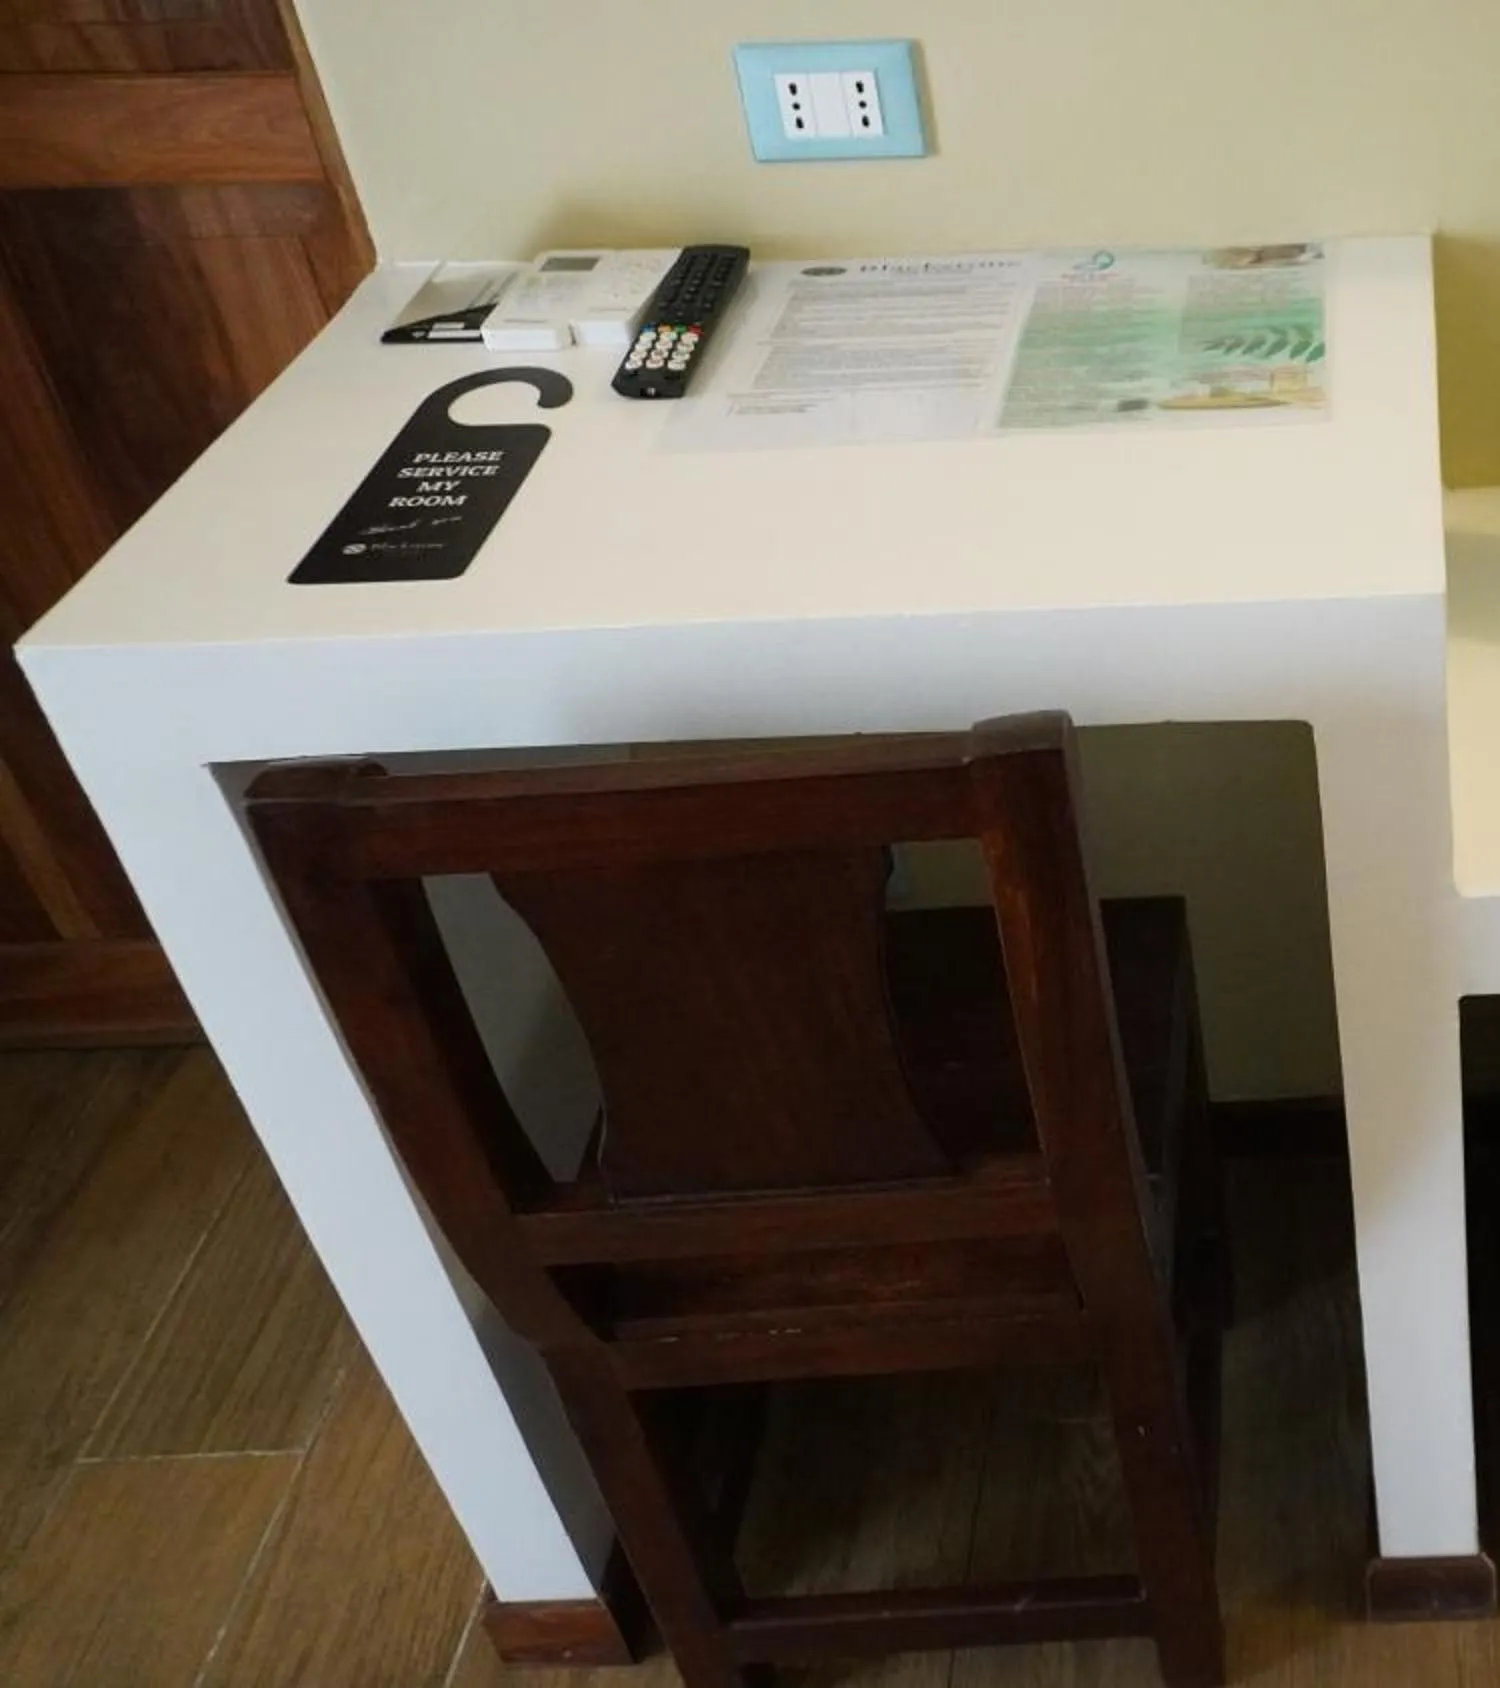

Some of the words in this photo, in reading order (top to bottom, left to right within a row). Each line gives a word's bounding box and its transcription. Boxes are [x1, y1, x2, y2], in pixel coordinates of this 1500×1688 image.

[412, 451, 505, 464] PLEASE
[396, 465, 500, 479] SERVICE
[416, 480, 462, 493] MY
[388, 495, 469, 508] ROOM
